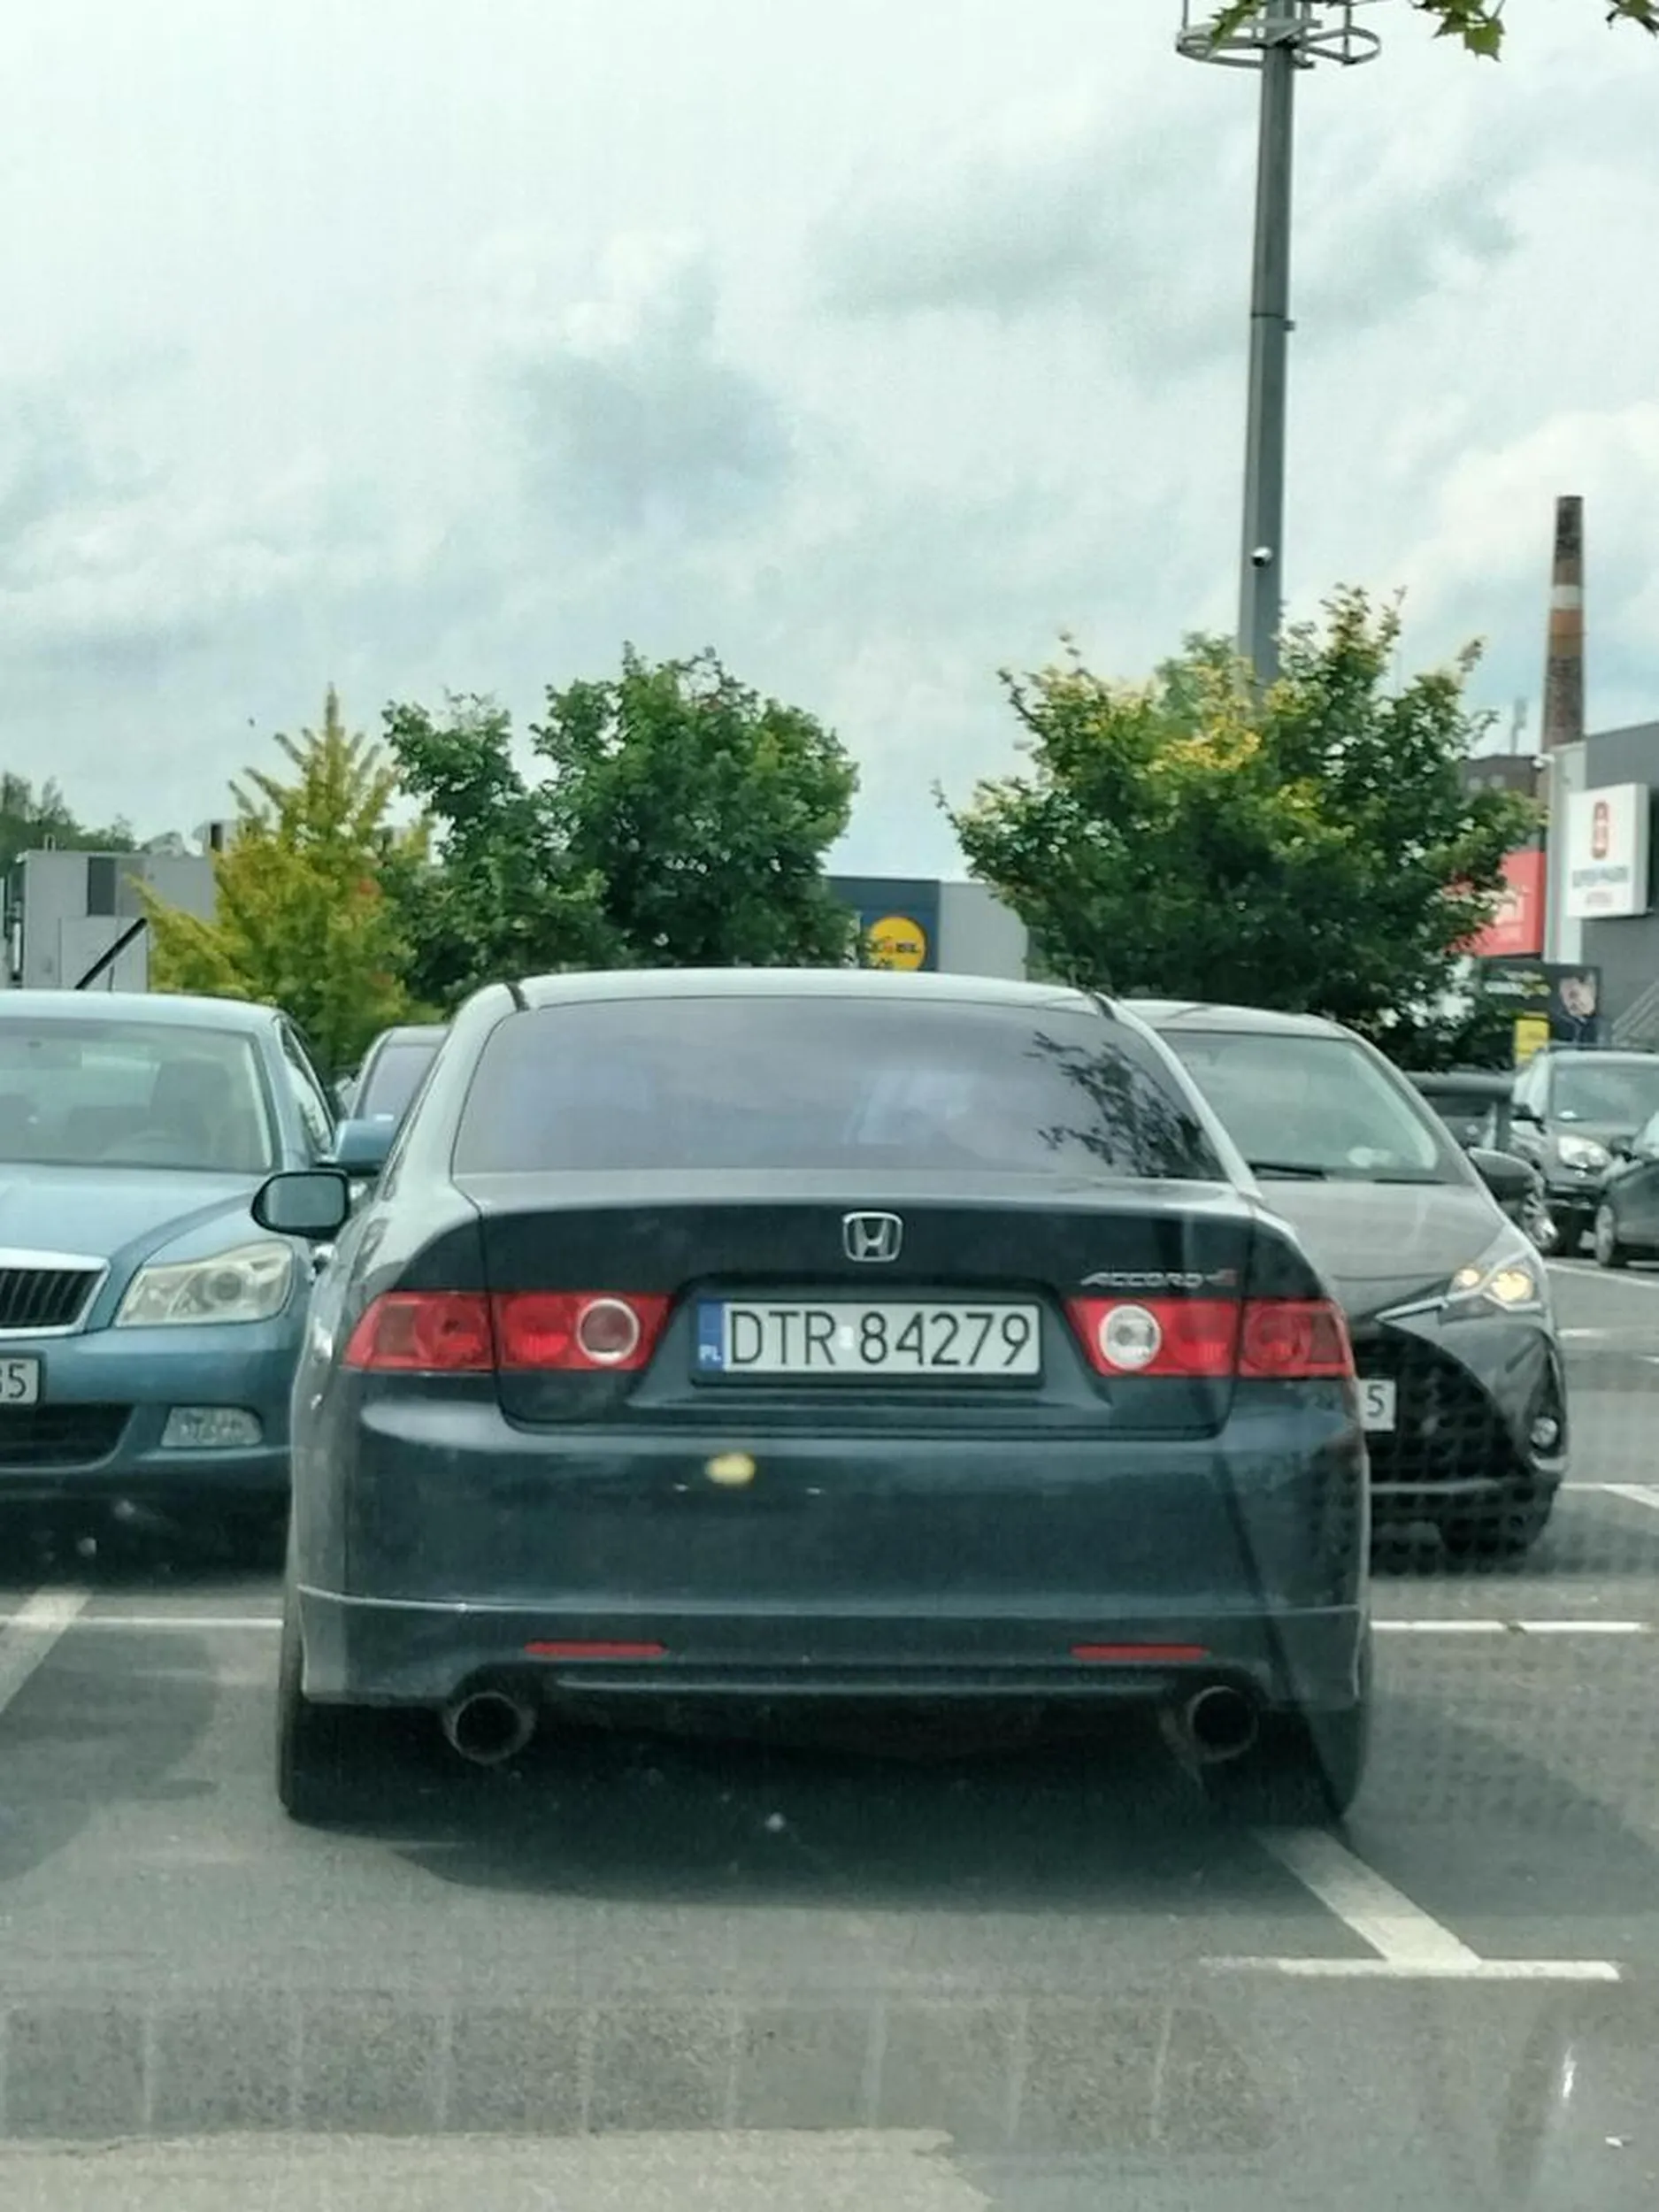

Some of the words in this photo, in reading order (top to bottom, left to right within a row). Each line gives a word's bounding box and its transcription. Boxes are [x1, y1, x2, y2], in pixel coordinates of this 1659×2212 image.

[1081, 1271, 1204, 1289] ACCORD
[730, 1310, 836, 1365] DTR
[859, 1311, 1031, 1366] 84279
[699, 1345, 721, 1362] PL
[0, 1363, 27, 1399] 5
